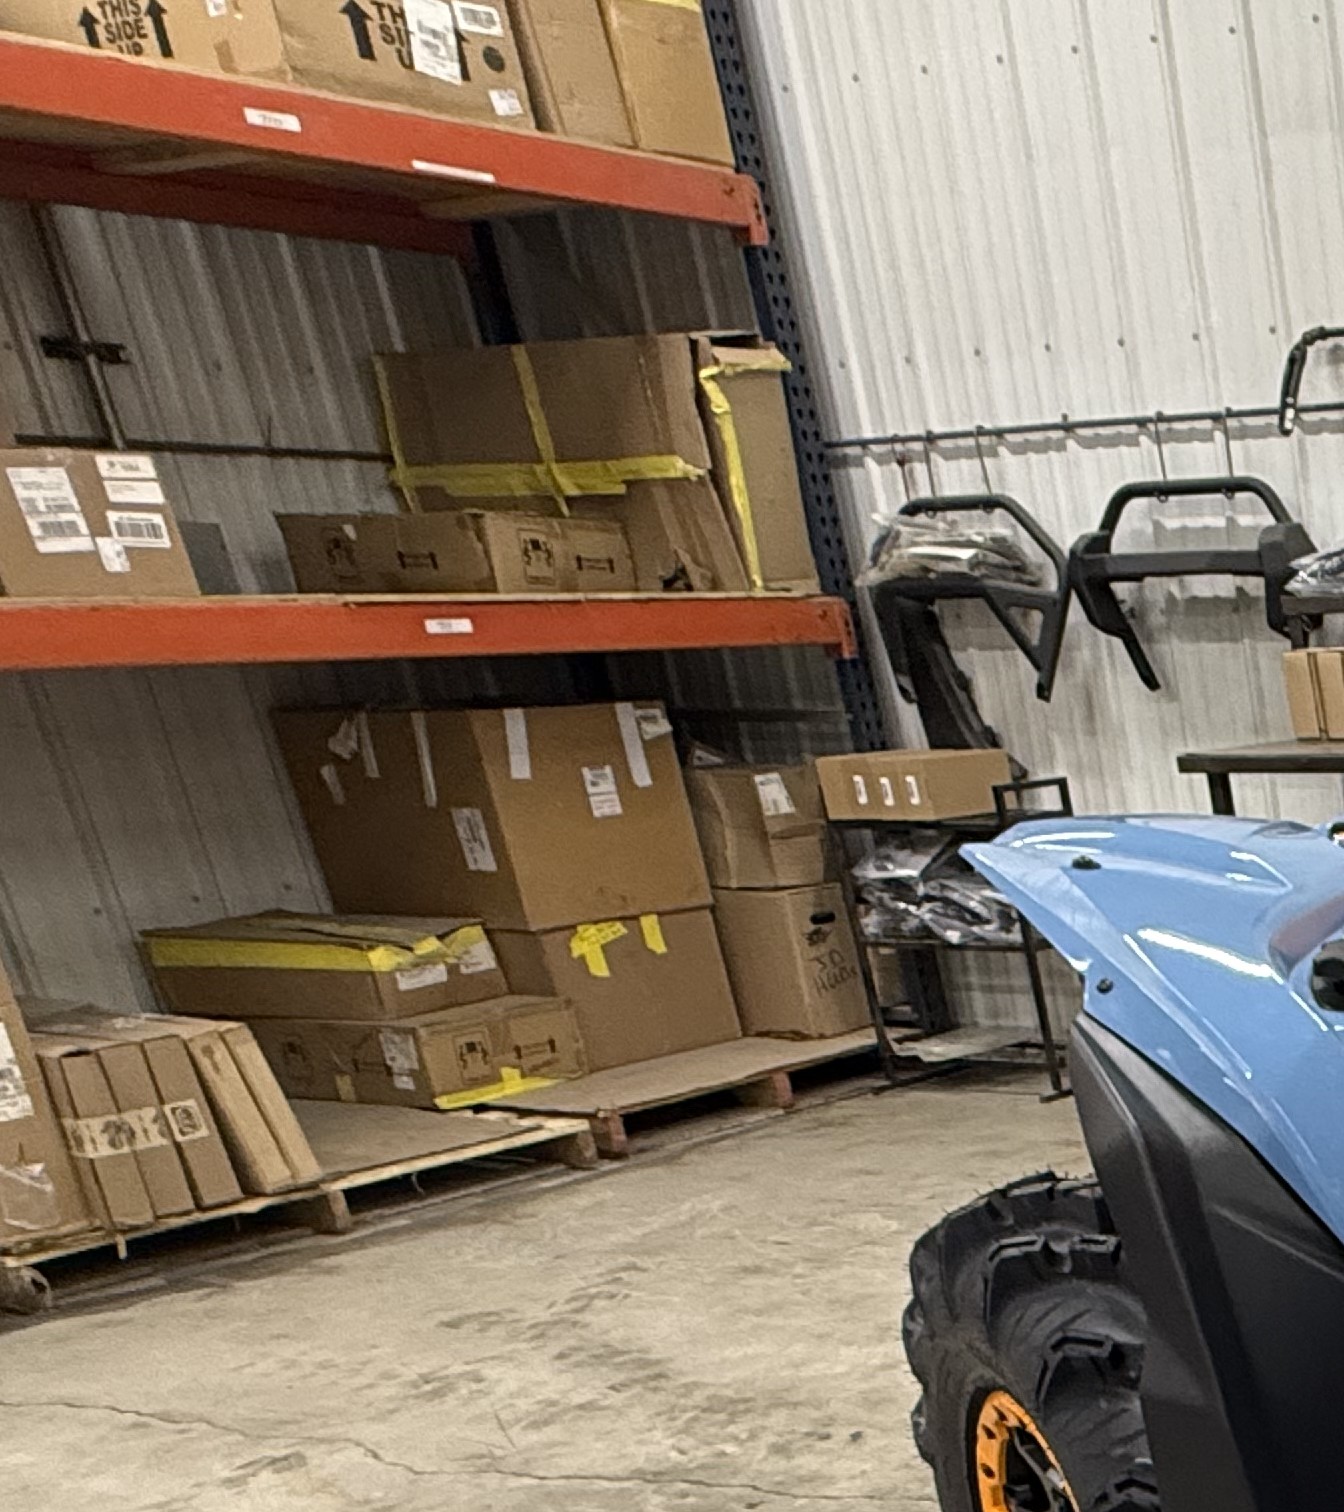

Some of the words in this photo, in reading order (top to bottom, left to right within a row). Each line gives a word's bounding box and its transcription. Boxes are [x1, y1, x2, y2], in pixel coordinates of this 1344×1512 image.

[97, 0, 142, 20] THIS
[369, 1, 407, 24] TH
[104, 17, 149, 44] SIDE
